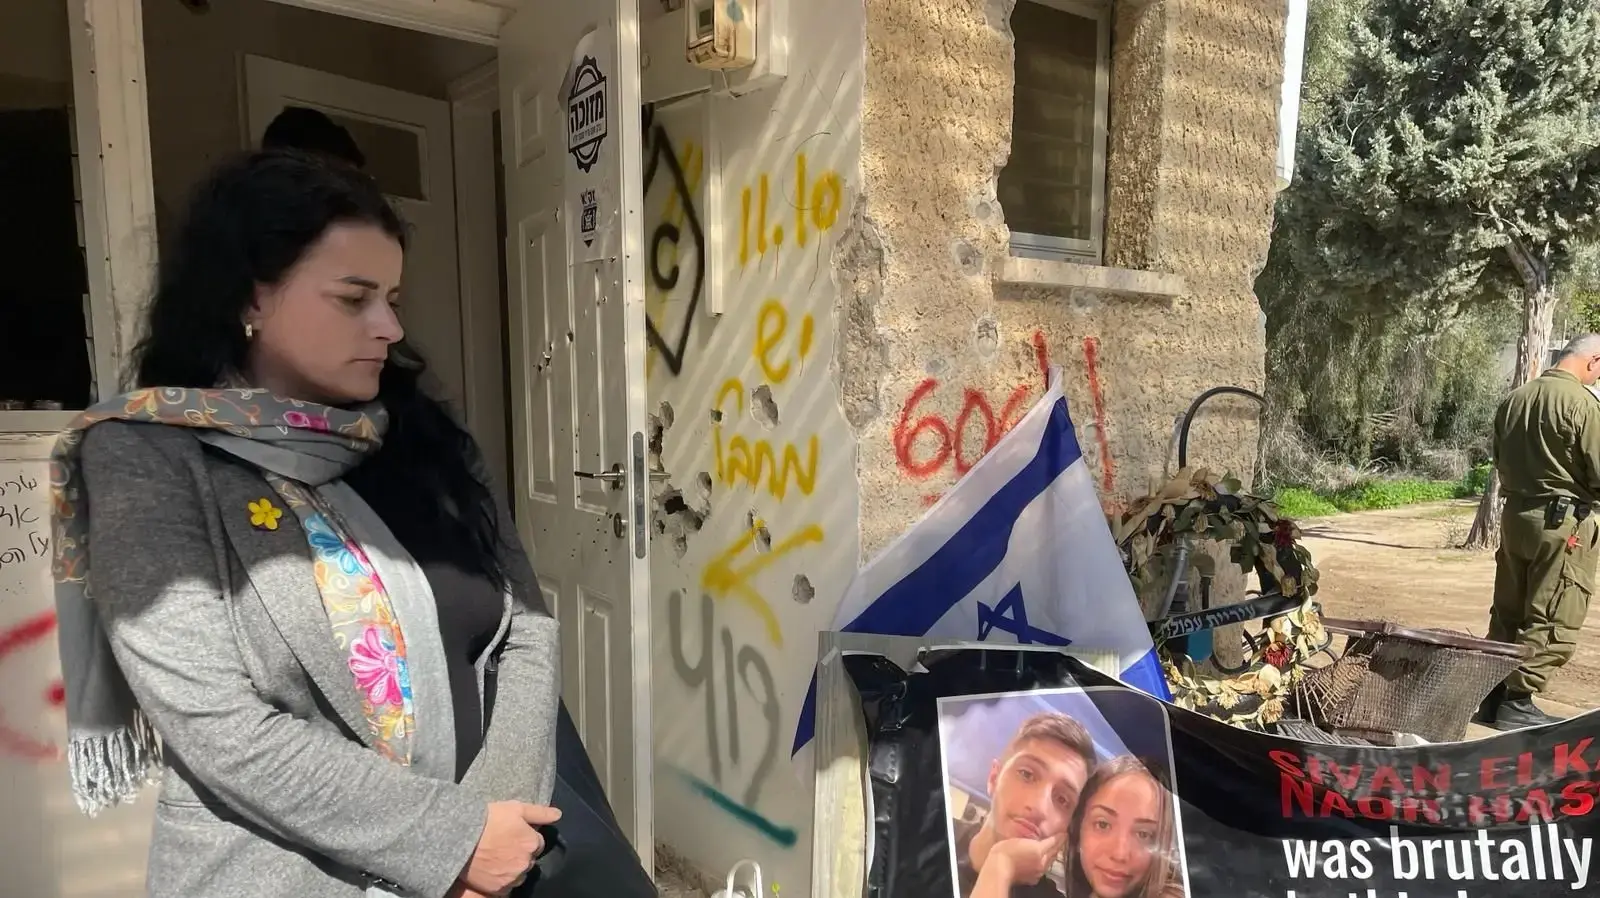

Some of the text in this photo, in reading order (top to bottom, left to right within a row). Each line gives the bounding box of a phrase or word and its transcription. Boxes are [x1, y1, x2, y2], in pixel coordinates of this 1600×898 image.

[738, 152, 841, 267] 11.10
[1268, 736, 1600, 795] SIVAN ELK
[1468, 780, 1600, 824] HAS
[1282, 823, 1593, 890] was brutally
